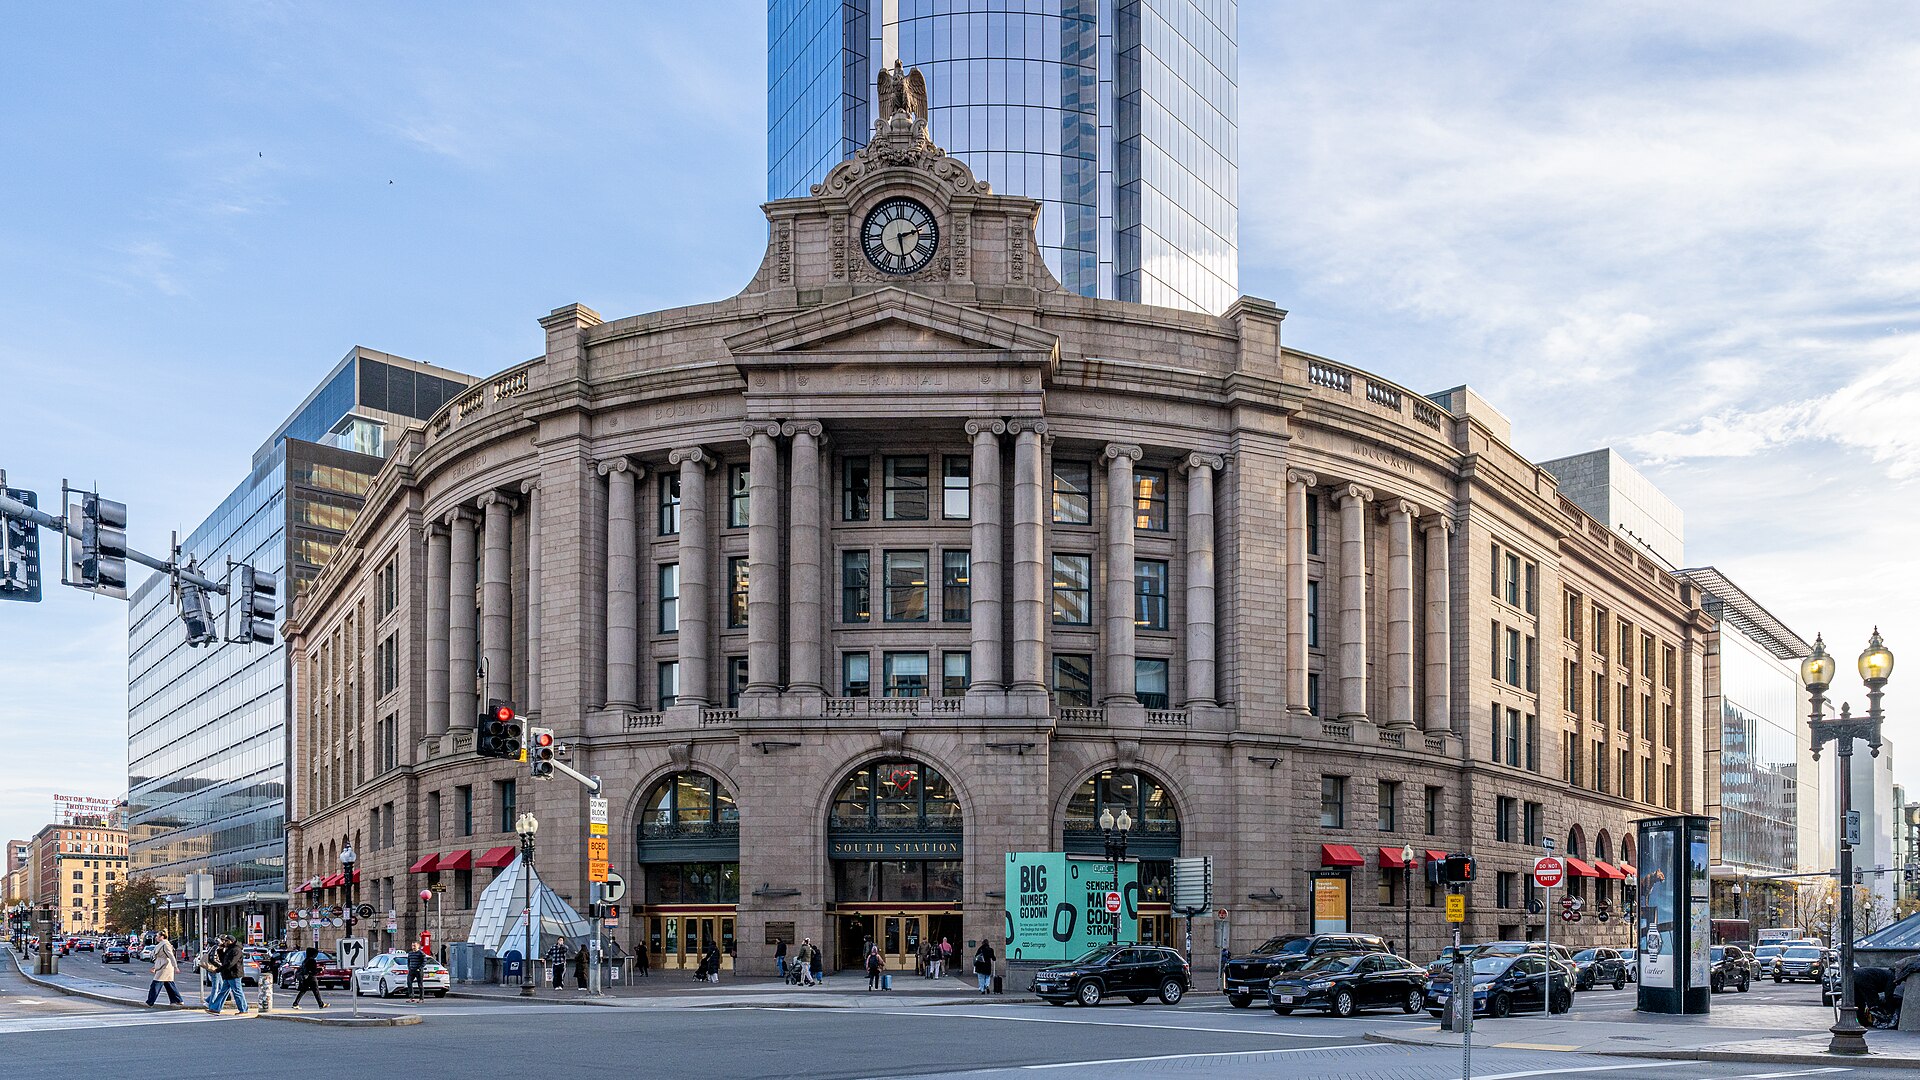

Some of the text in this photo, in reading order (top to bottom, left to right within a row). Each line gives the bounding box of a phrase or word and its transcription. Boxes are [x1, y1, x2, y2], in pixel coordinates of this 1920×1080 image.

[844, 374, 942, 386] TERMINAL
[655, 401, 719, 420] BOSTON
[1082, 397, 1163, 416] COMPANY
[1353, 442, 1415, 474] MDCCCXCVII
[453, 456, 487, 480] ERECTED
[54, 794, 83, 803] BOSTON
[86, 796, 109, 804] WHARF
[66, 803, 109, 812] INDUSTRIAL
[591, 842, 606, 851] BCEC
[835, 843, 957, 852] SOUTH STATION
[1020, 865, 1047, 893] BIG
[602, 881, 621, 897] T
[1086, 881, 1115, 890] SEMGRE
[1020, 893, 1048, 906] NUMBER
[1020, 906, 1048, 919] GO DOWN
[1086, 925, 1113, 935] STRON
[1644, 965, 1666, 975] Cartier
